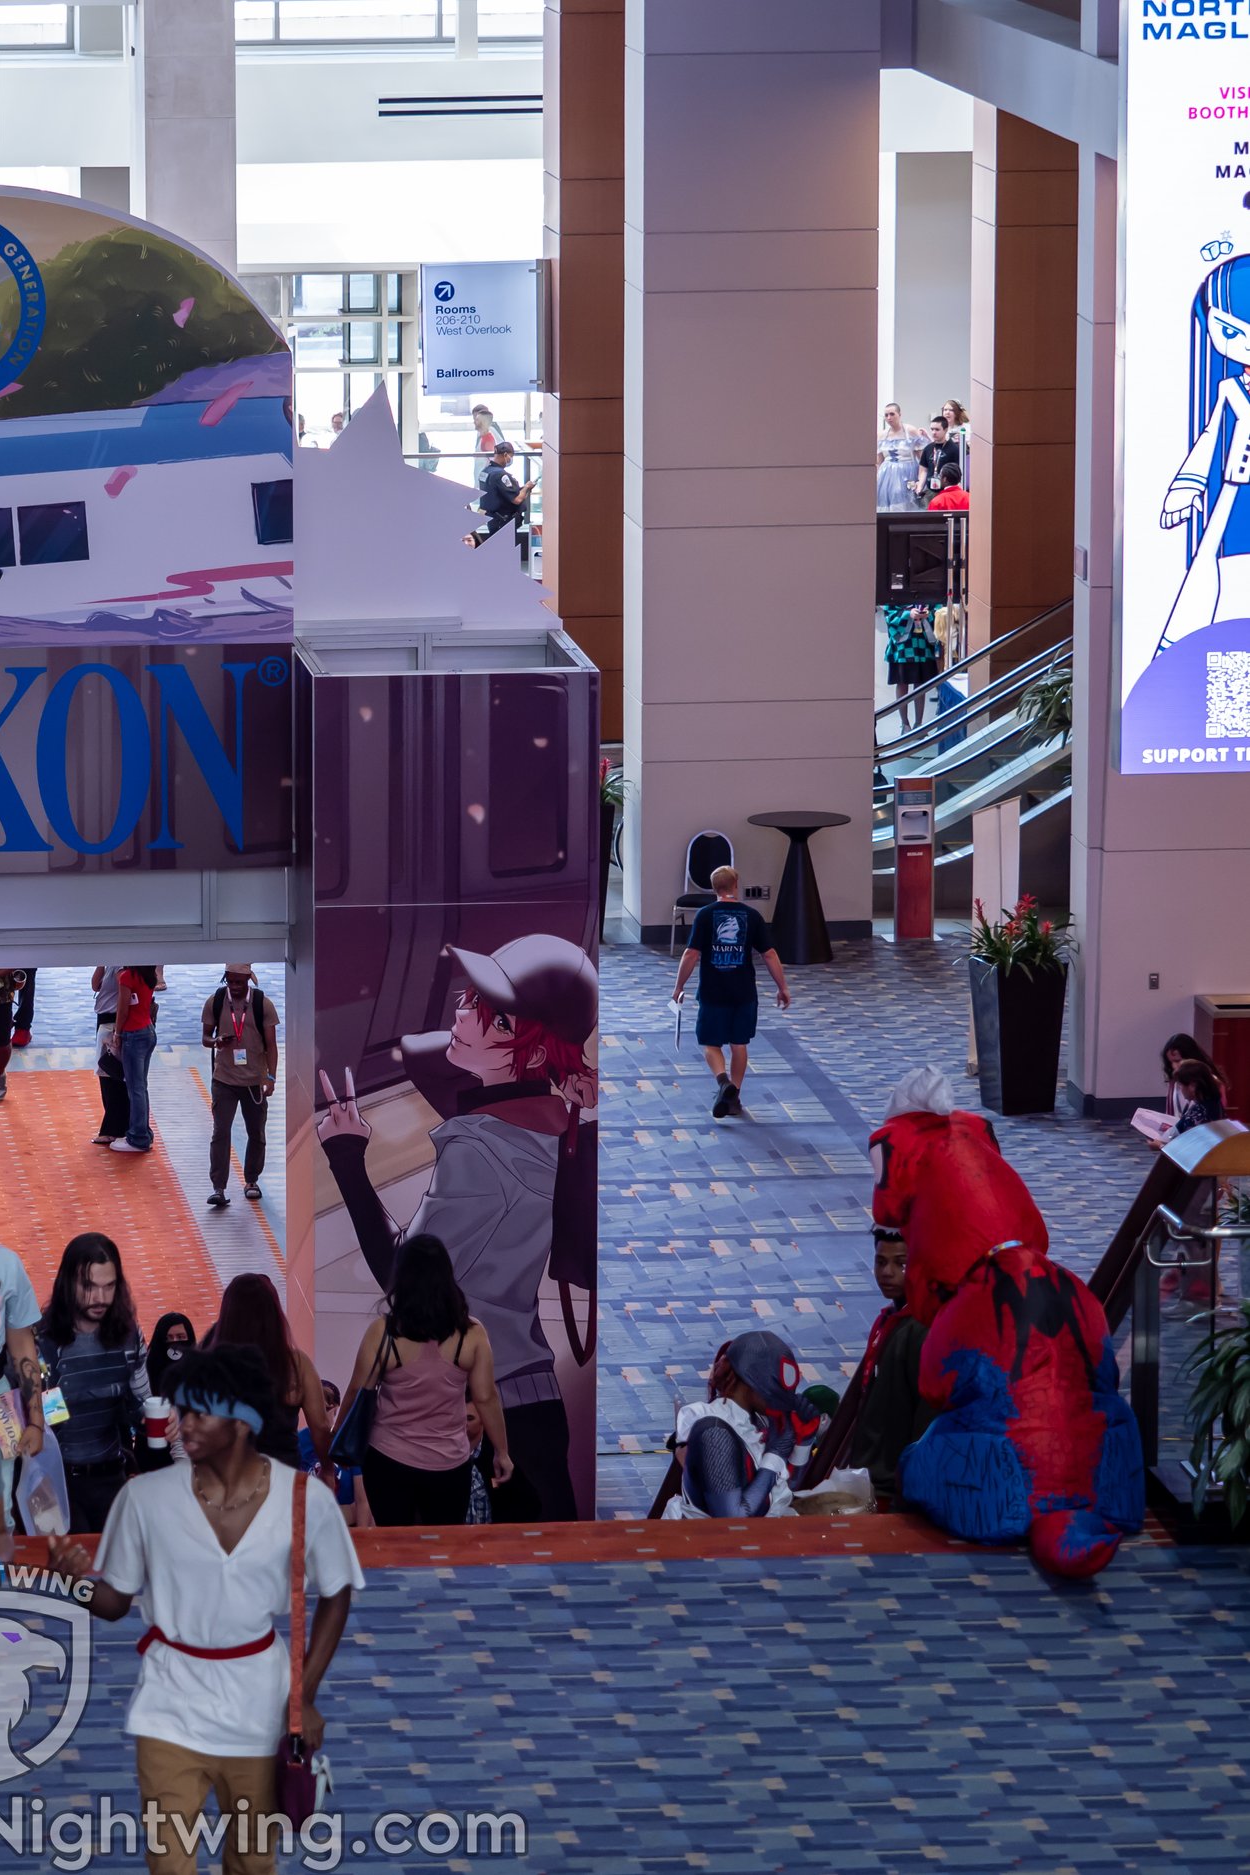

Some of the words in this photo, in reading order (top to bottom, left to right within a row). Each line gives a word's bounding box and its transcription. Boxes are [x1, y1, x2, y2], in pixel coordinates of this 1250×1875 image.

[1188, 106, 1249, 120] BOOTH
[1215, 165, 1250, 179] MA
[3, 242, 40, 367] GENERATION
[435, 305, 476, 314] Rooms
[435, 315, 481, 325] 206-210
[436, 326, 462, 336] West
[465, 324, 512, 335] Overlook
[436, 368, 495, 378] Ballrooms
[1142, 747, 1230, 764] SUPPORT
